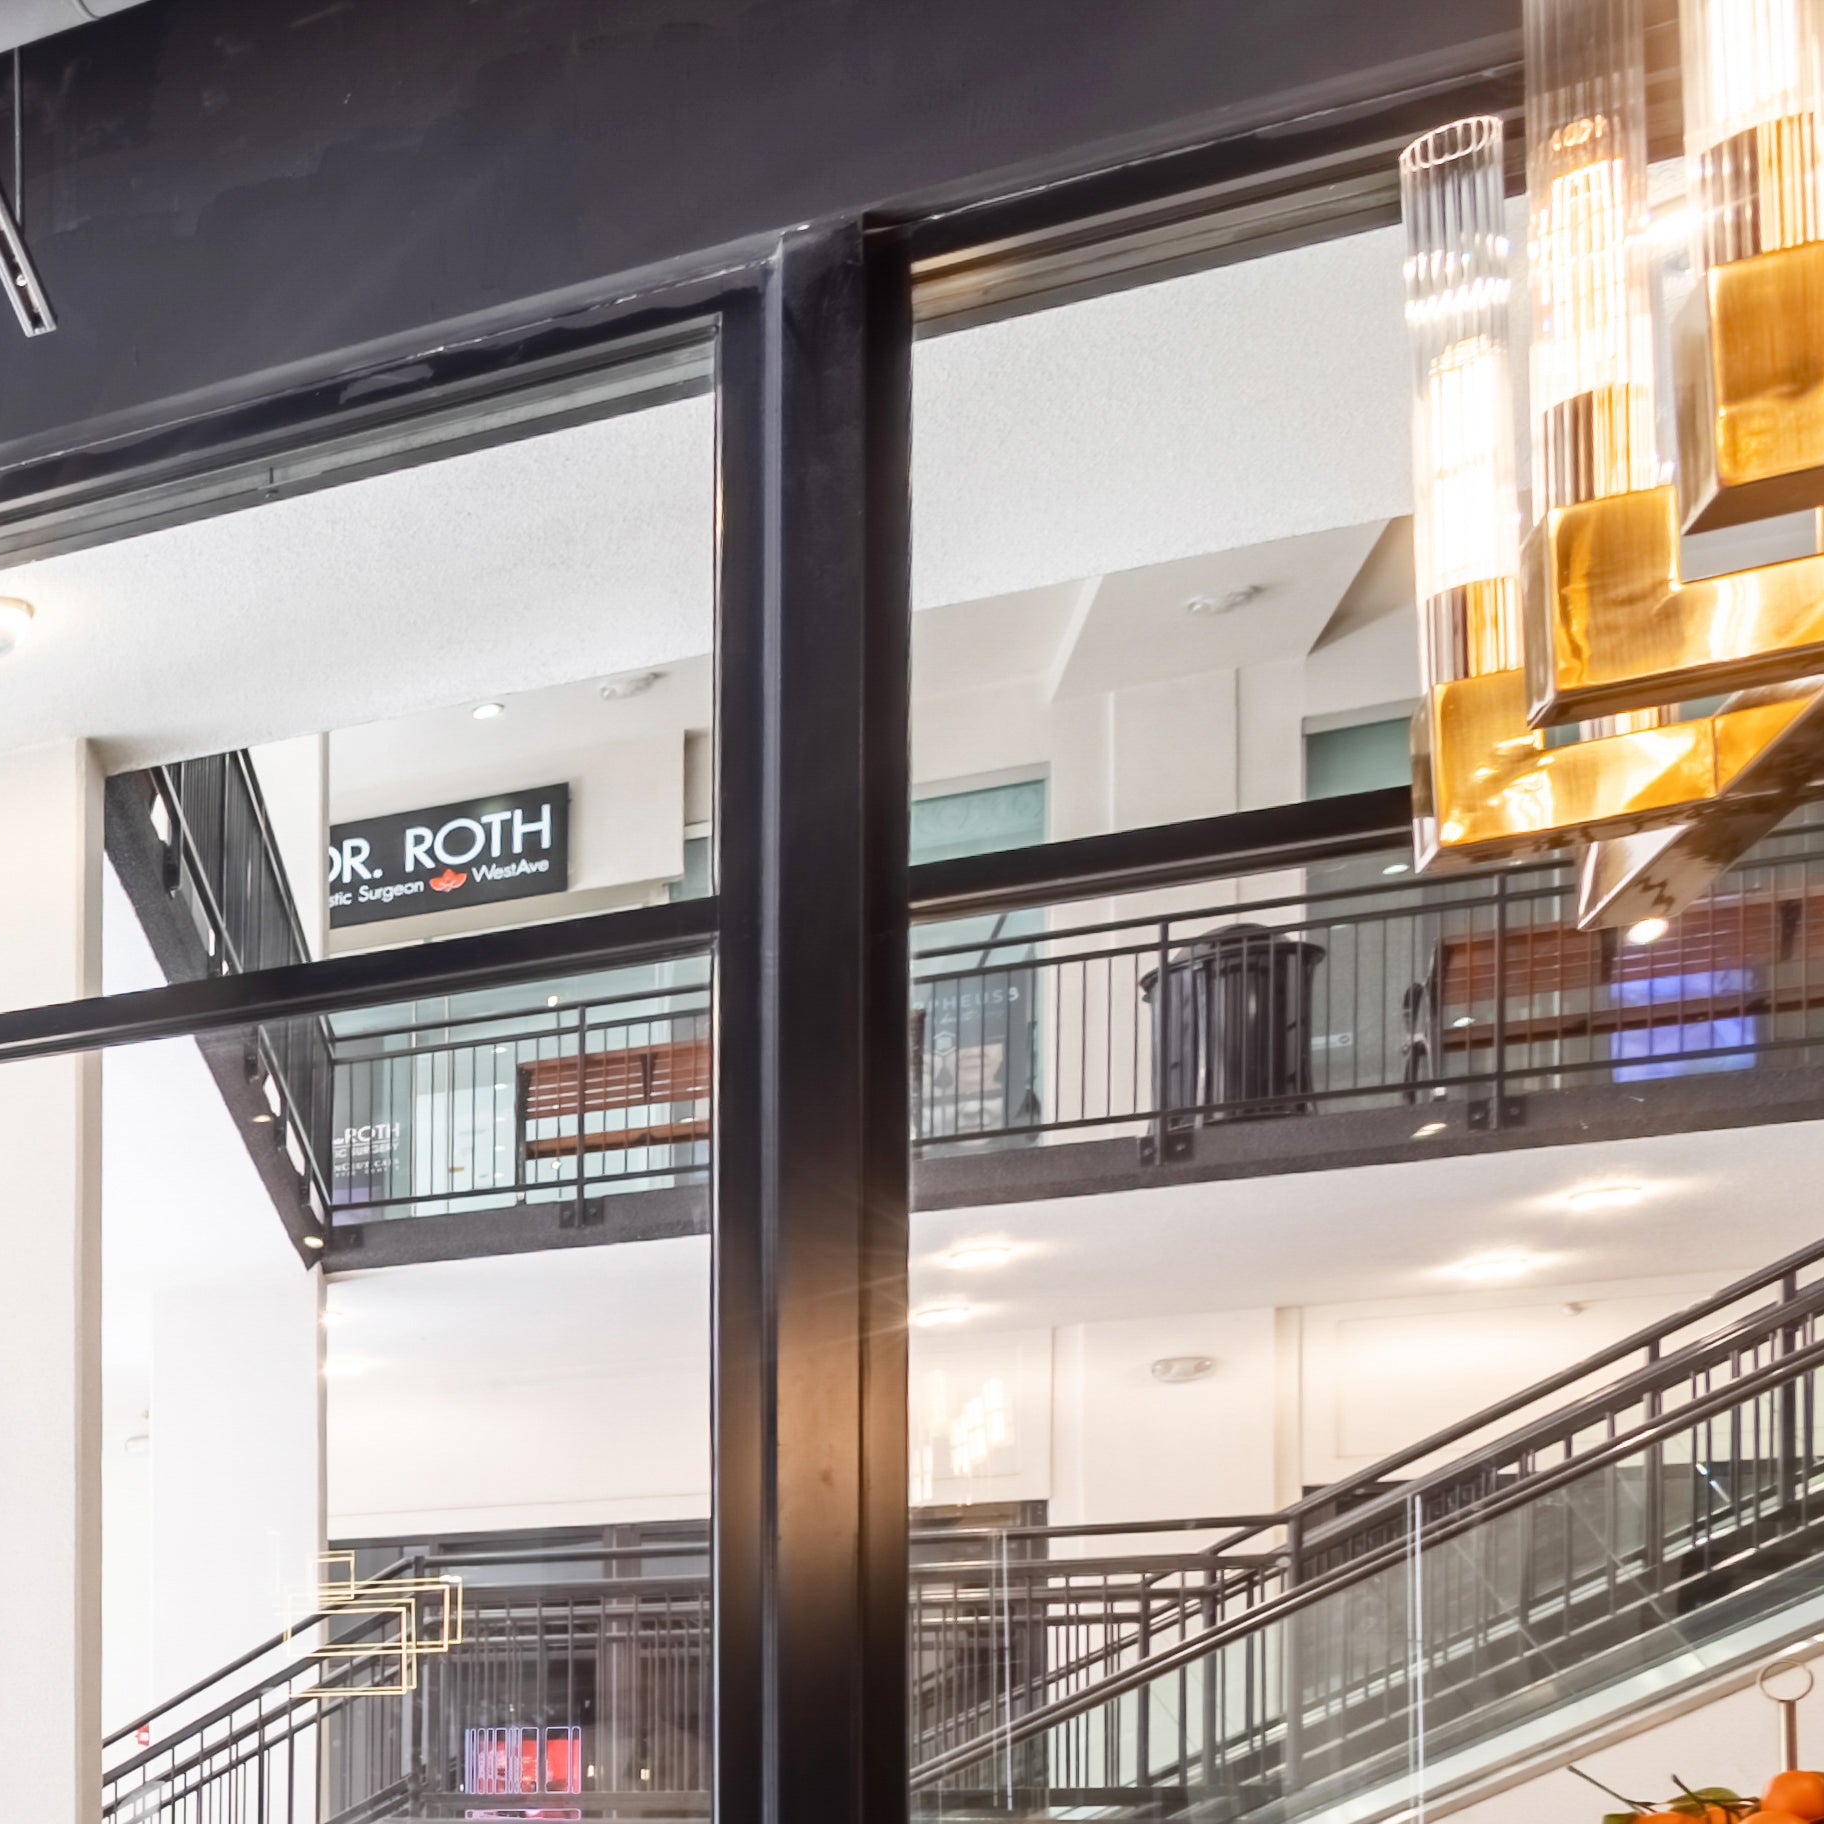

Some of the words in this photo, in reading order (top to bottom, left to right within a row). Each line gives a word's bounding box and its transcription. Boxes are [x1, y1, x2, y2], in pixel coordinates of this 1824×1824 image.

[404, 803, 552, 873] ROTH
[358, 880, 425, 903] Surgeon
[471, 858, 550, 883] WestAve
